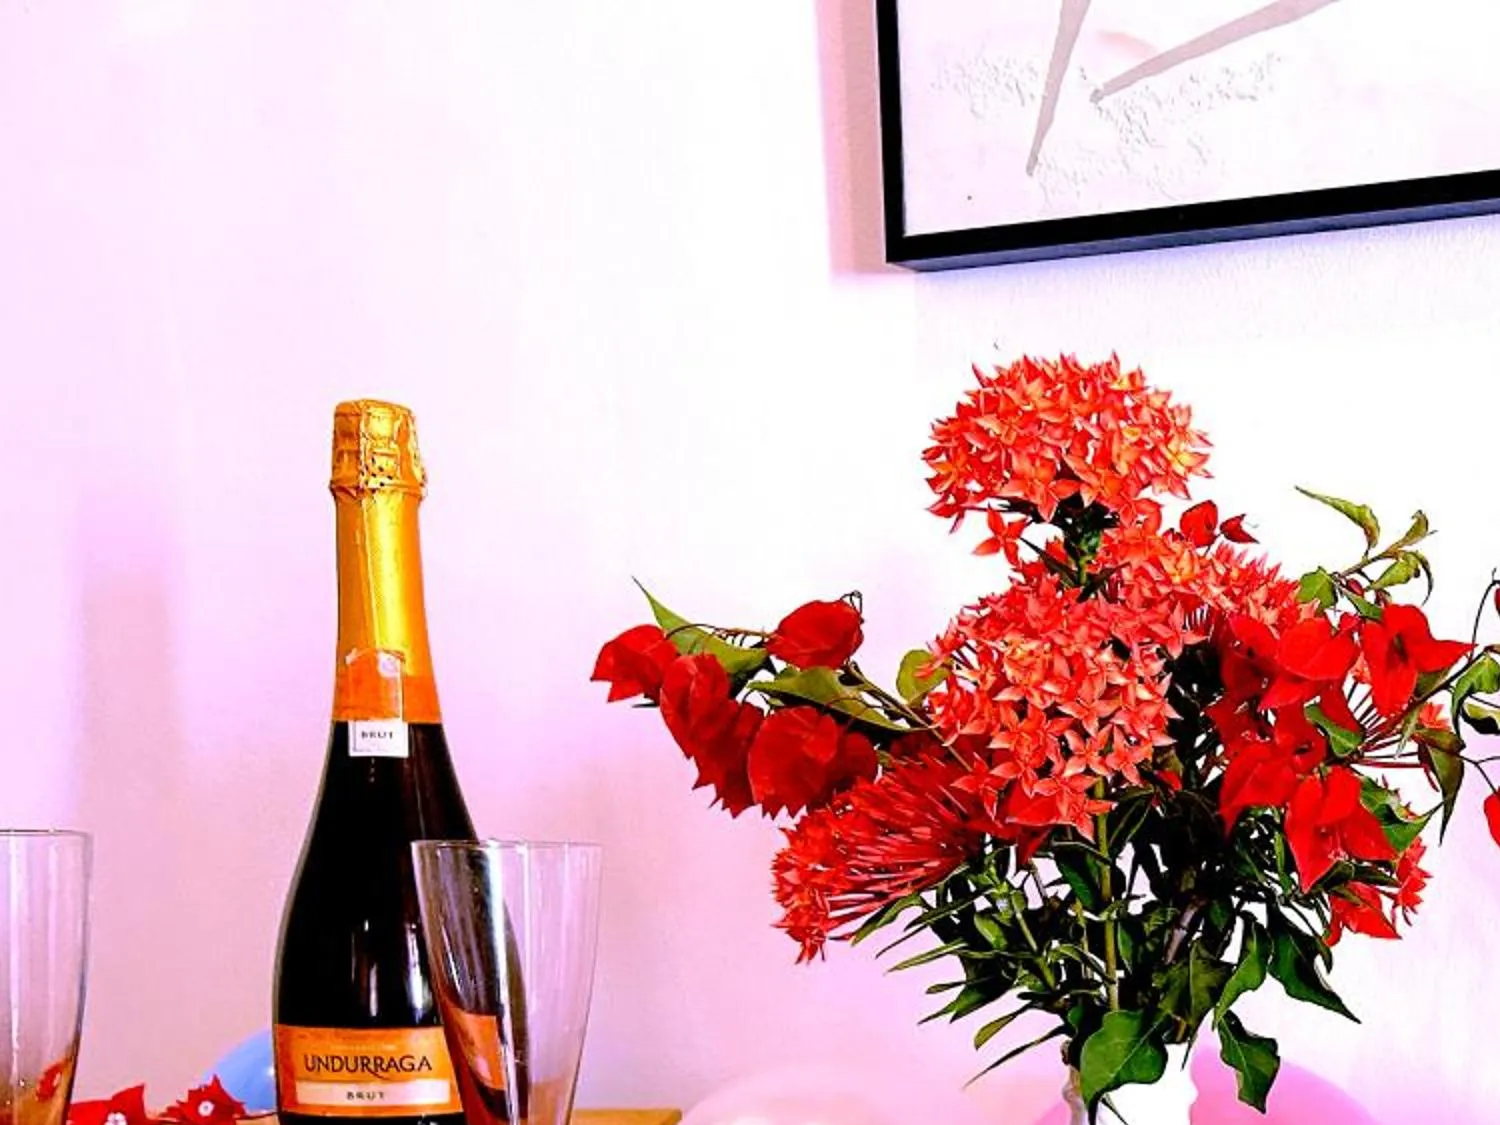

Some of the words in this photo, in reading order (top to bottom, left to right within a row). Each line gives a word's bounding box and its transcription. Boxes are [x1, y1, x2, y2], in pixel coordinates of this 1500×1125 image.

[361, 730, 393, 740] BRUT
[303, 1054, 433, 1080] UNDURRAGA
[346, 1091, 385, 1101] BRUT
